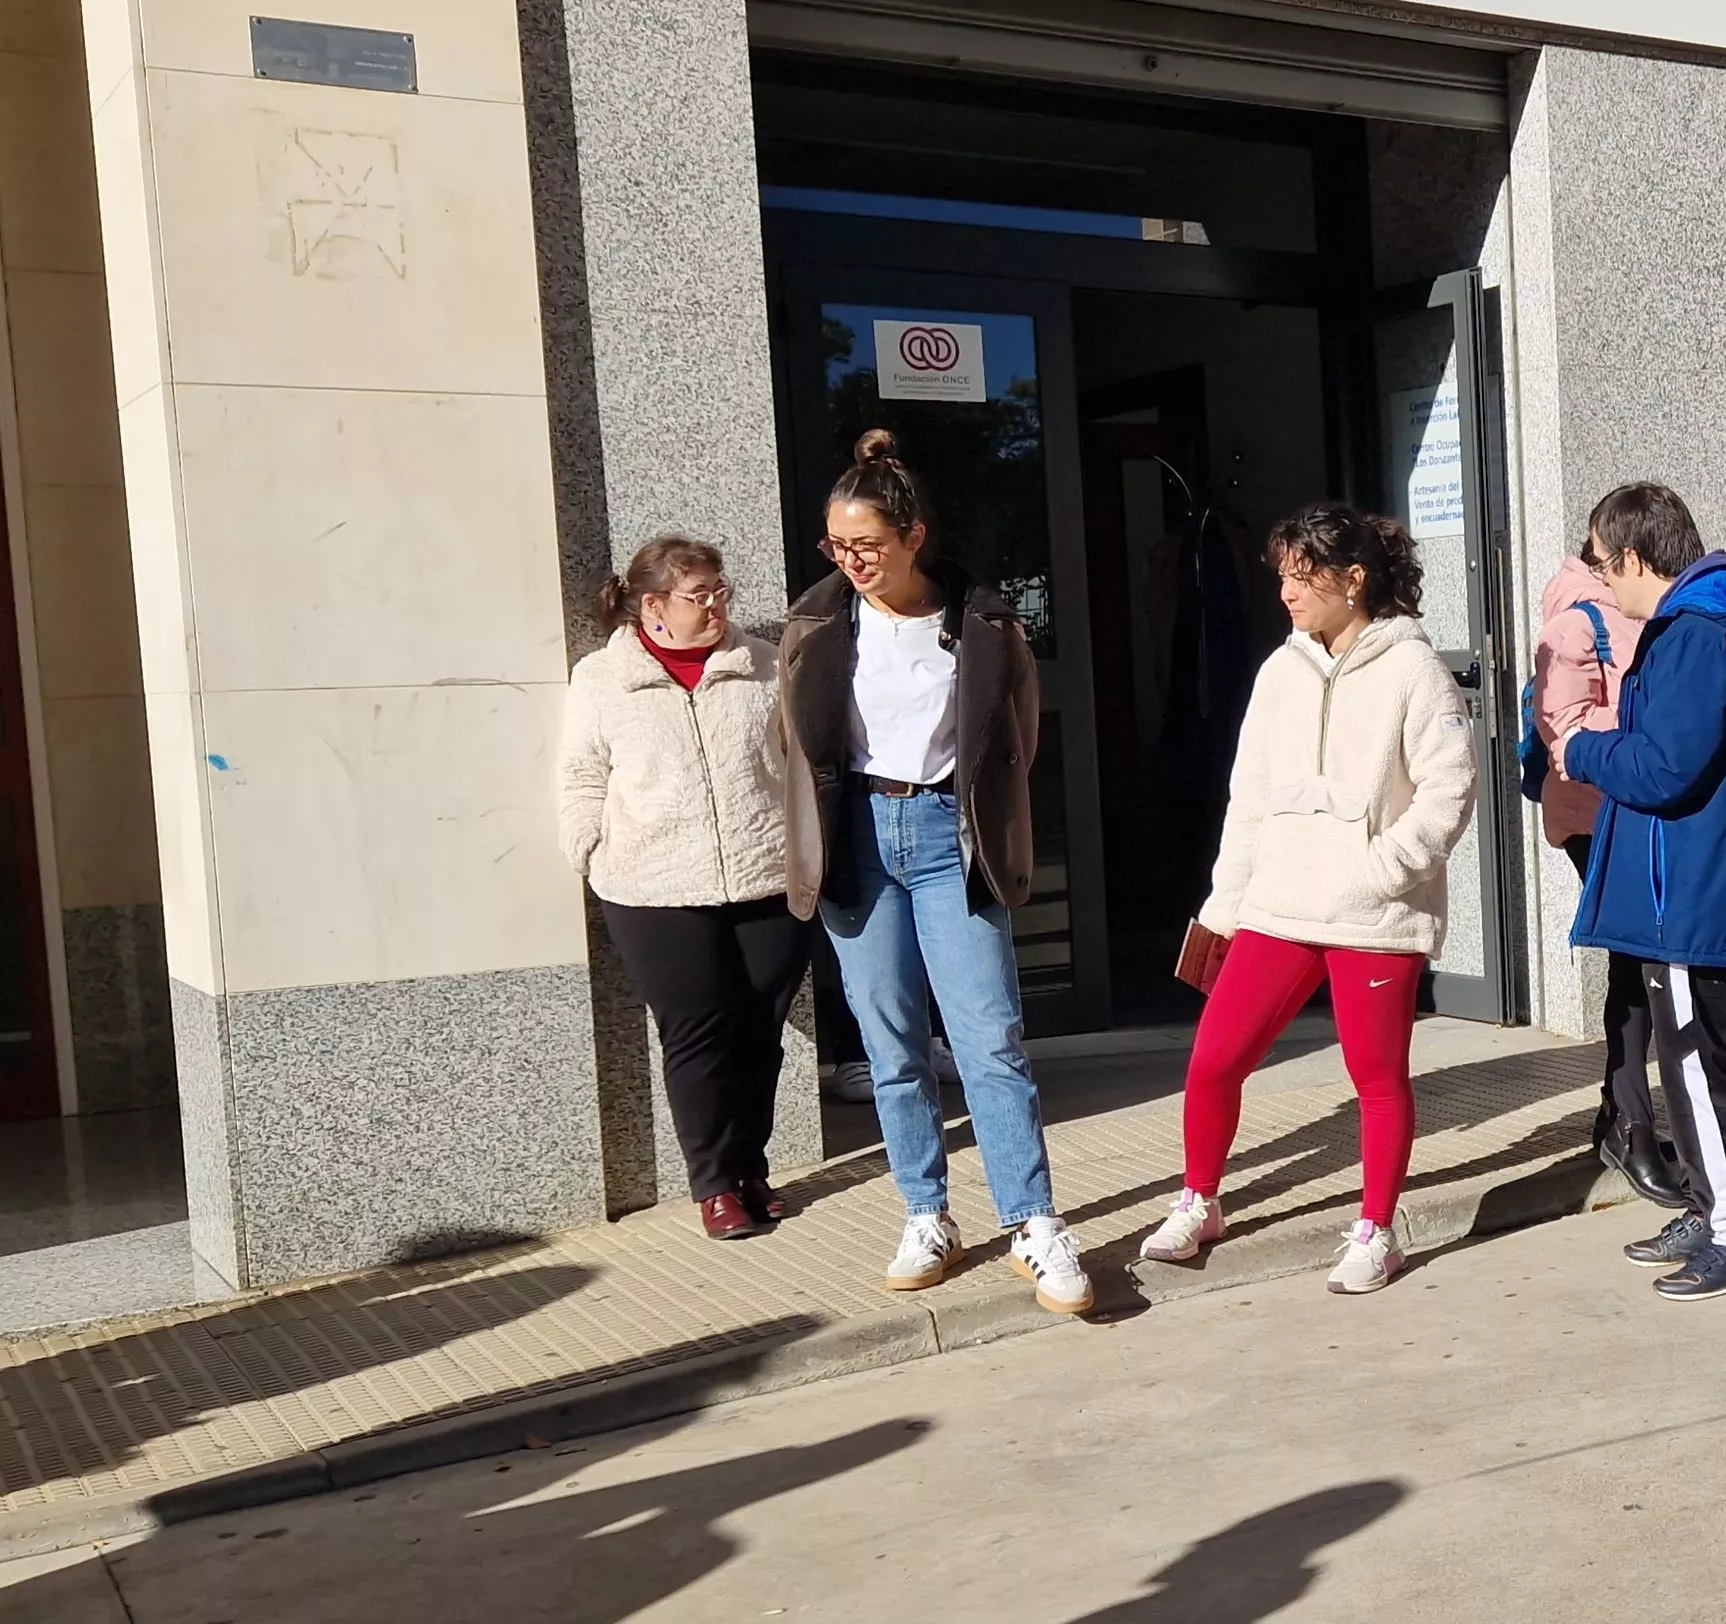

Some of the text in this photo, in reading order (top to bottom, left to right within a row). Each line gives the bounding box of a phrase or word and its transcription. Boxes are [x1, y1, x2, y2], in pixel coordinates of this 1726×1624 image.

[893, 373, 970, 385] Fundación ONCE
[1434, 397, 1443, 408] de
[1445, 396, 1459, 406] For
[1449, 409, 1460, 420] La
[1411, 440, 1460, 454] Centro Ocupa
[1429, 453, 1461, 466] Danzant
[1448, 480, 1459, 491] del
[1414, 499, 1435, 510] Venta
[1436, 497, 1445, 507] de
[1421, 510, 1465, 523] encuaderna
